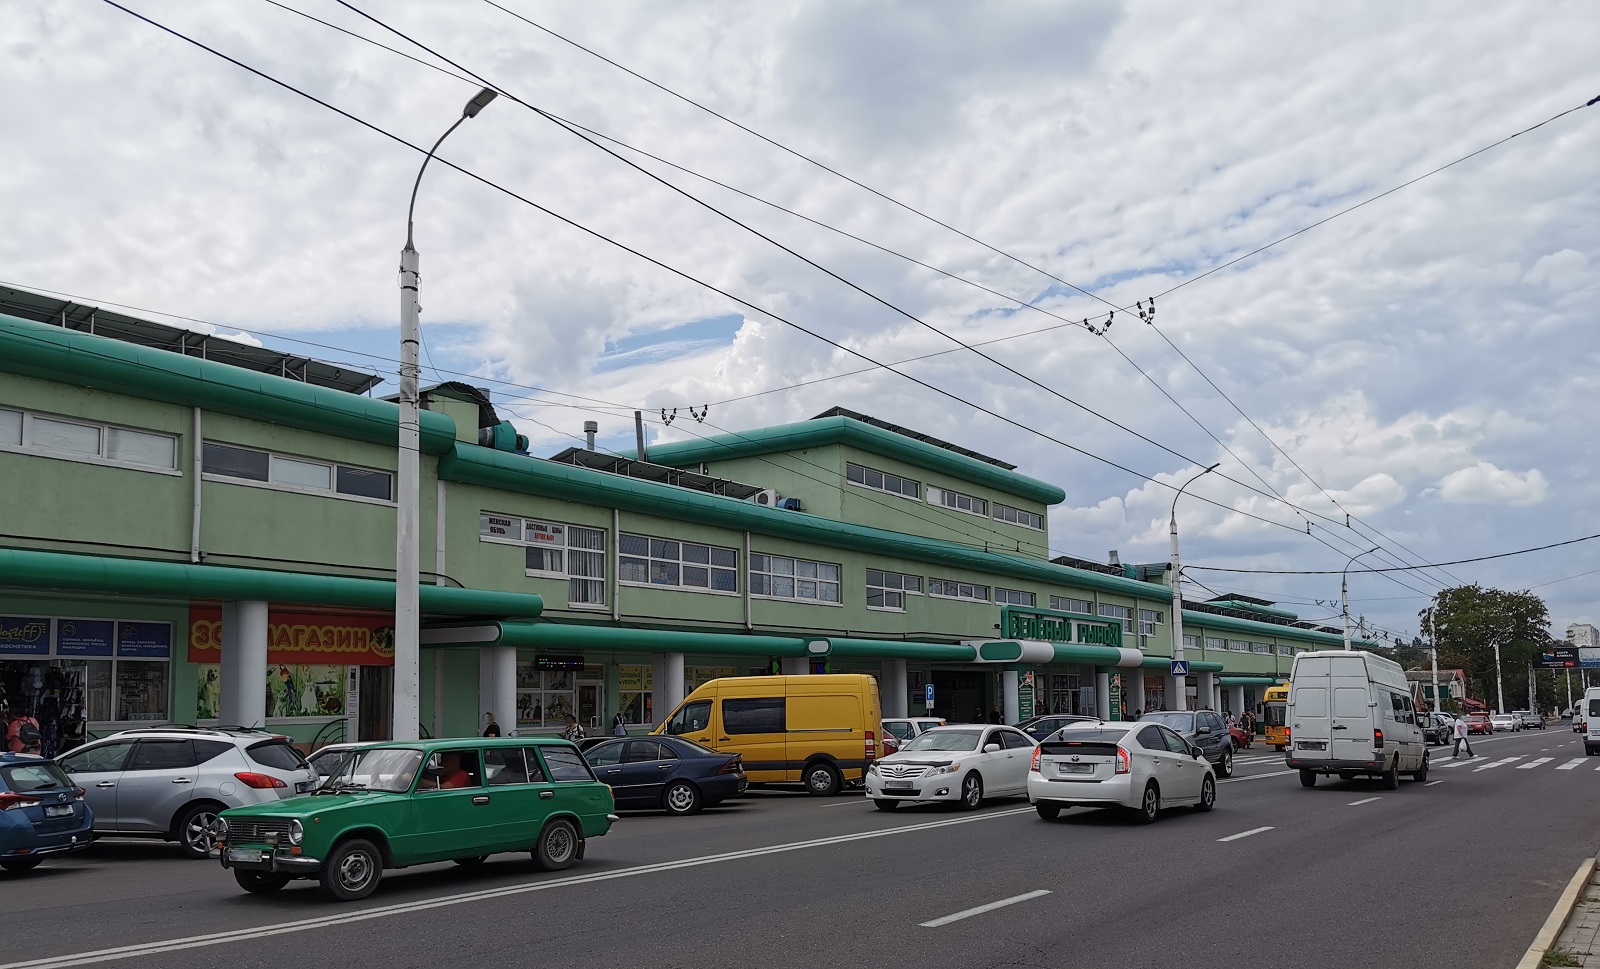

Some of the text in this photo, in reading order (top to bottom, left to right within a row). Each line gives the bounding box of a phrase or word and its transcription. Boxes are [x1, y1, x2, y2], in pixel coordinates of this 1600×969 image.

[1010, 611, 1119, 647] ЗЕЛЁНЫЙ РЫНОК
[927, 686, 933, 699] P
